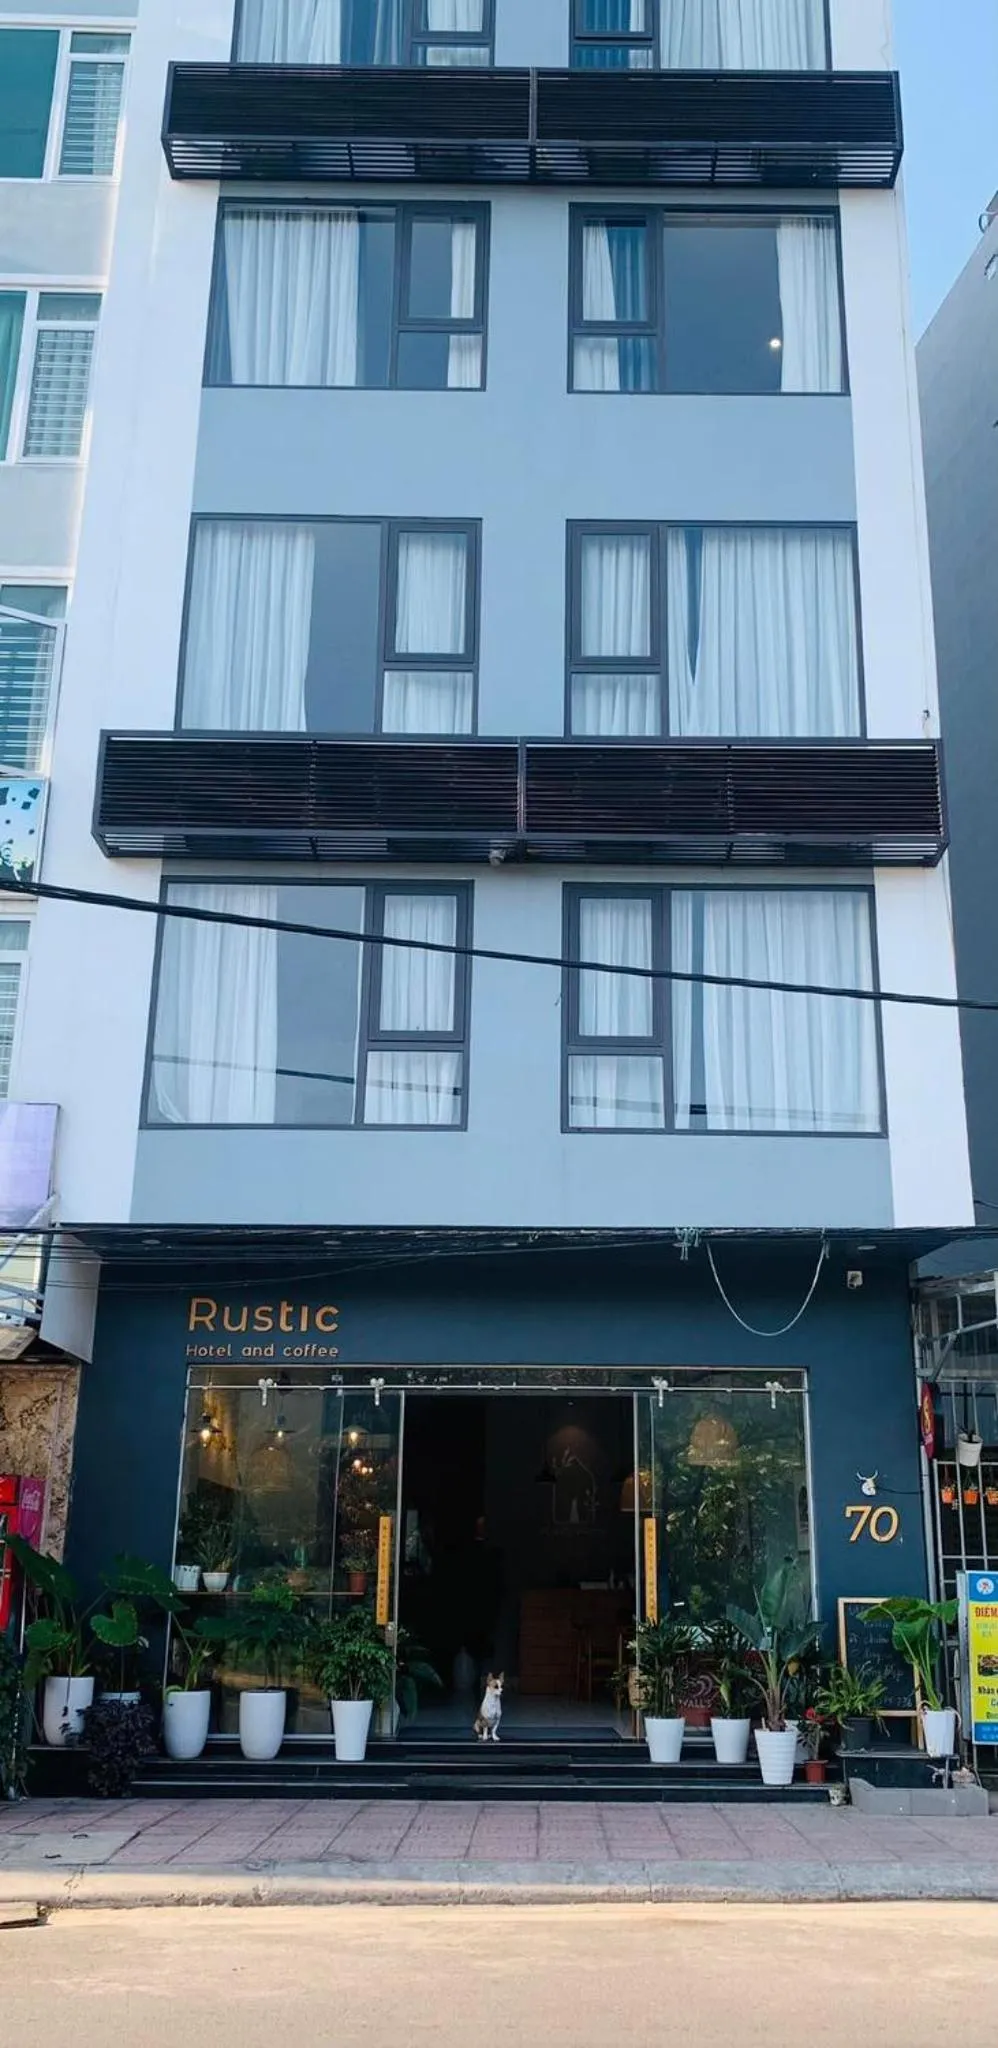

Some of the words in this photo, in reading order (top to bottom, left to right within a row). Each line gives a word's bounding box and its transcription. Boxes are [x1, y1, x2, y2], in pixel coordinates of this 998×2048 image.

[188, 1297, 340, 1332] Rustic
[186, 1344, 232, 1357] Hotel
[242, 1344, 274, 1357] and
[283, 1344, 339, 1358] coffee
[845, 1505, 899, 1542] 70
